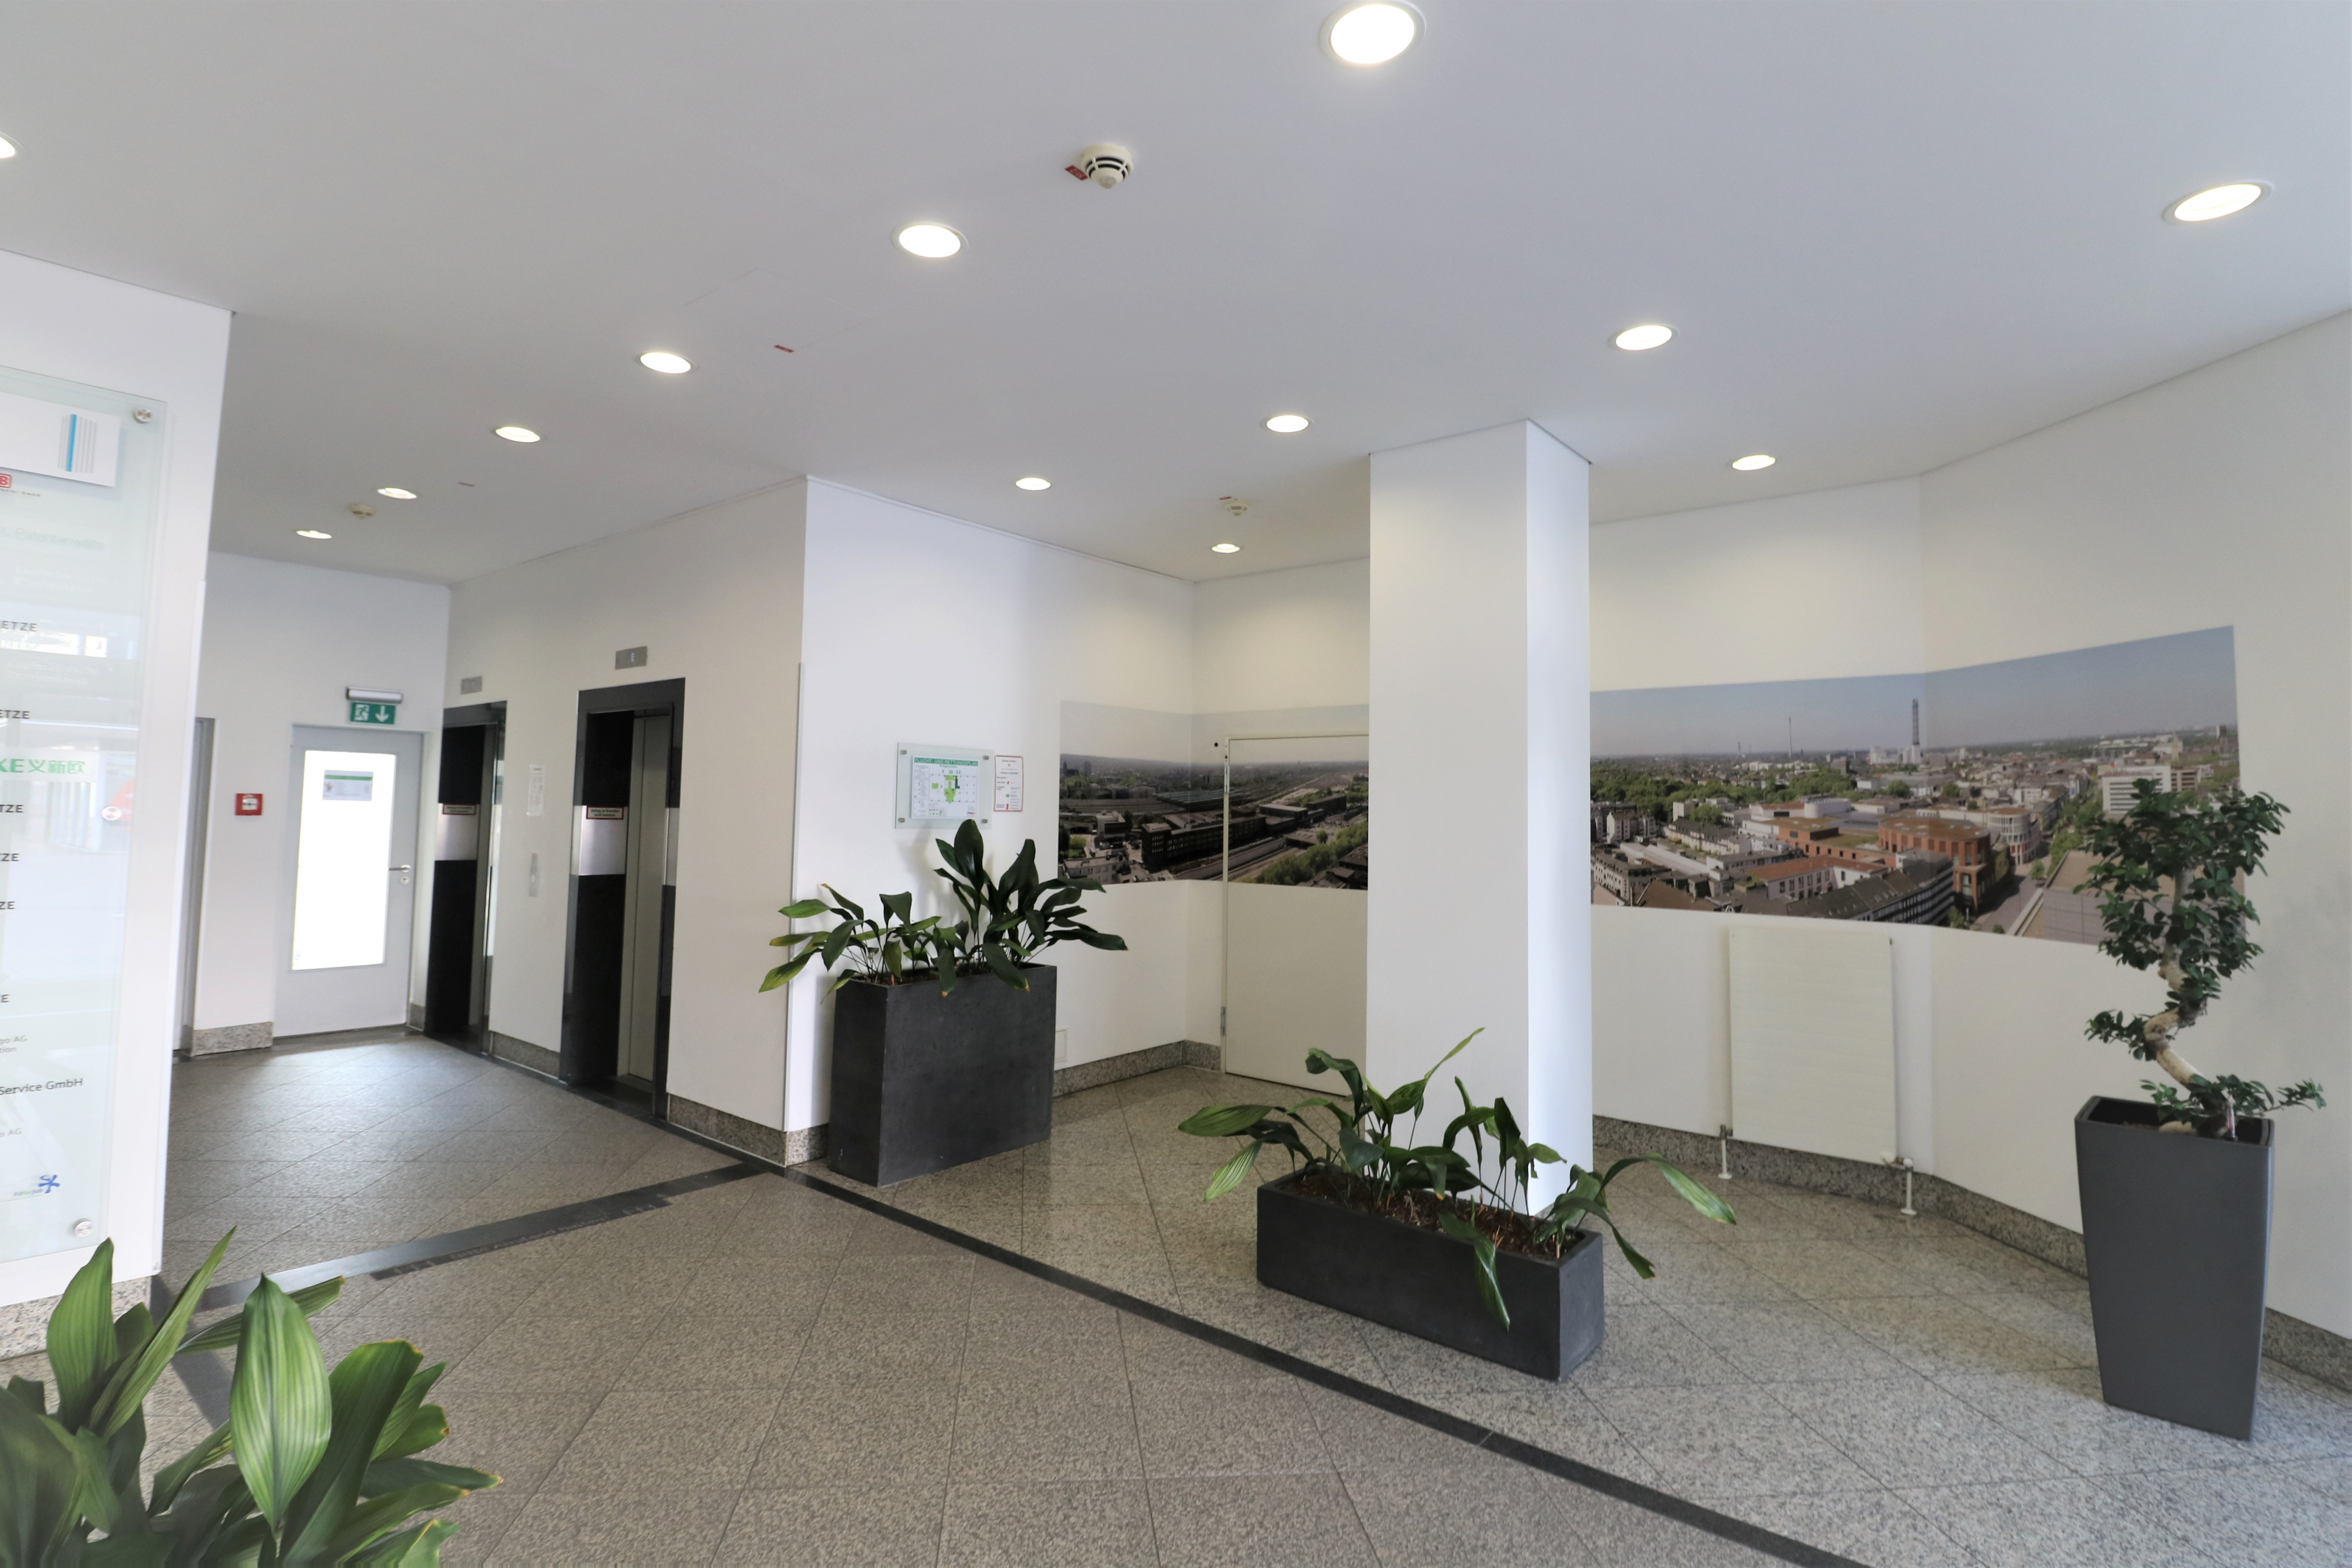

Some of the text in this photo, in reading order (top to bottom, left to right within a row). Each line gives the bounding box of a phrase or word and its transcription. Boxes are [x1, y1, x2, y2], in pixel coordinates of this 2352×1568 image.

[0, 620, 37, 631] ETZE
[0, 1078, 83, 1095] Service GmbH
